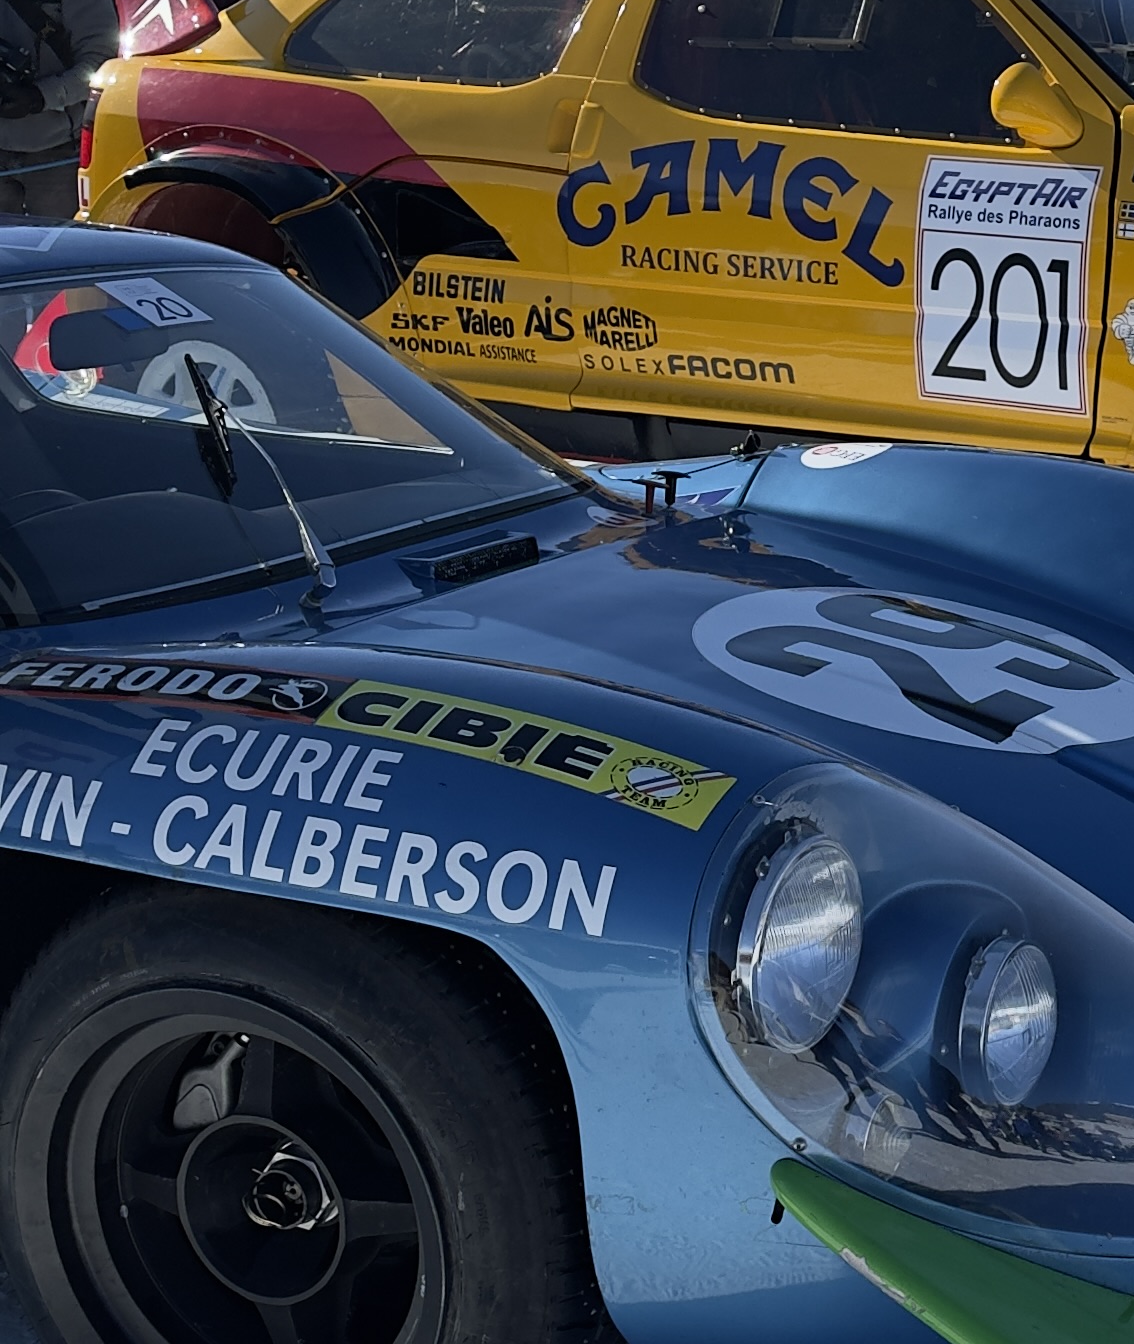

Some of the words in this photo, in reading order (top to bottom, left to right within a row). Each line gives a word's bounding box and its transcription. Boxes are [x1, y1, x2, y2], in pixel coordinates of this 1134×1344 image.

[556, 138, 905, 288] CAMEL
[927, 204, 973, 225] Rallye
[977, 208, 1004, 224] des
[1008, 210, 1081, 230] Pharaons
[620, 244, 720, 275] RACING
[727, 253, 839, 286] SERVICE
[413, 270, 505, 304] BILSTEIN
[136, 297, 193, 321] 20
[391, 312, 450, 331] SKF
[456, 306, 515, 339] Valeo
[583, 306, 657, 332] MAGNETI
[930, 247, 1069, 390] 201
[388, 336, 476, 358] MONDIAL
[479, 342, 538, 364] ASSISTANCE
[583, 326, 657, 352] MARELLI
[583, 353, 665, 376] SOLEX
[0, 661, 262, 701] FERODO
[130, 718, 404, 813] ECURIE
[631, 759, 695, 786] RACING
[621, 784, 667, 808] TEAM
[153, 795, 617, 937] CALBERSON
